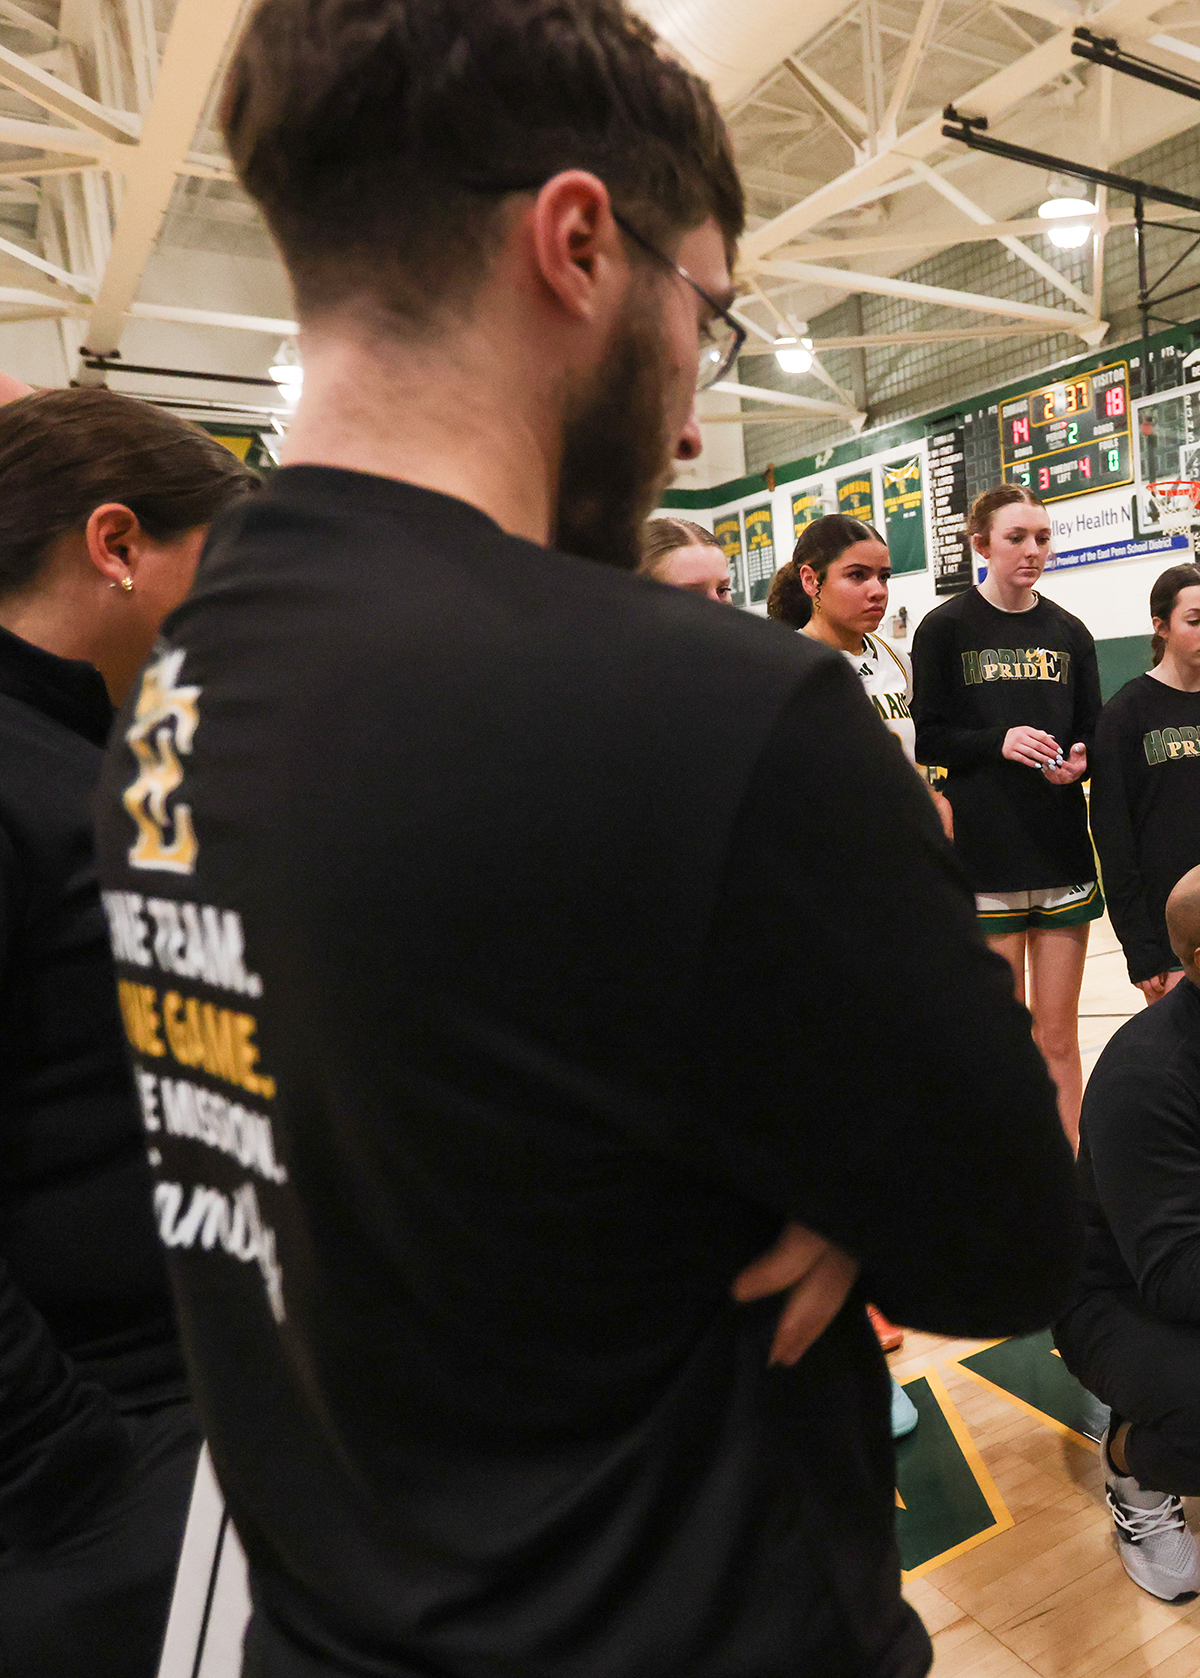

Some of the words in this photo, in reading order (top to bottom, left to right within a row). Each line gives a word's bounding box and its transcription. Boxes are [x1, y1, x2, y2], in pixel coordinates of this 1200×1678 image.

[1093, 368, 1125, 388] VISITOR
[1012, 417, 1030, 445] 14
[1068, 422, 1079, 444] 2
[1038, 467, 1050, 490] 3
[1057, 472, 1072, 484] LEFT
[1078, 457, 1091, 478] 4
[1076, 507, 1118, 532] Health
[1056, 554, 1079, 566] Provider
[1080, 552, 1086, 562] of
[1087, 551, 1096, 561] the
[1097, 549, 1110, 560] East
[1110, 546, 1126, 557] Penn
[1126, 542, 1148, 554] School
[1149, 537, 1172, 550] District
